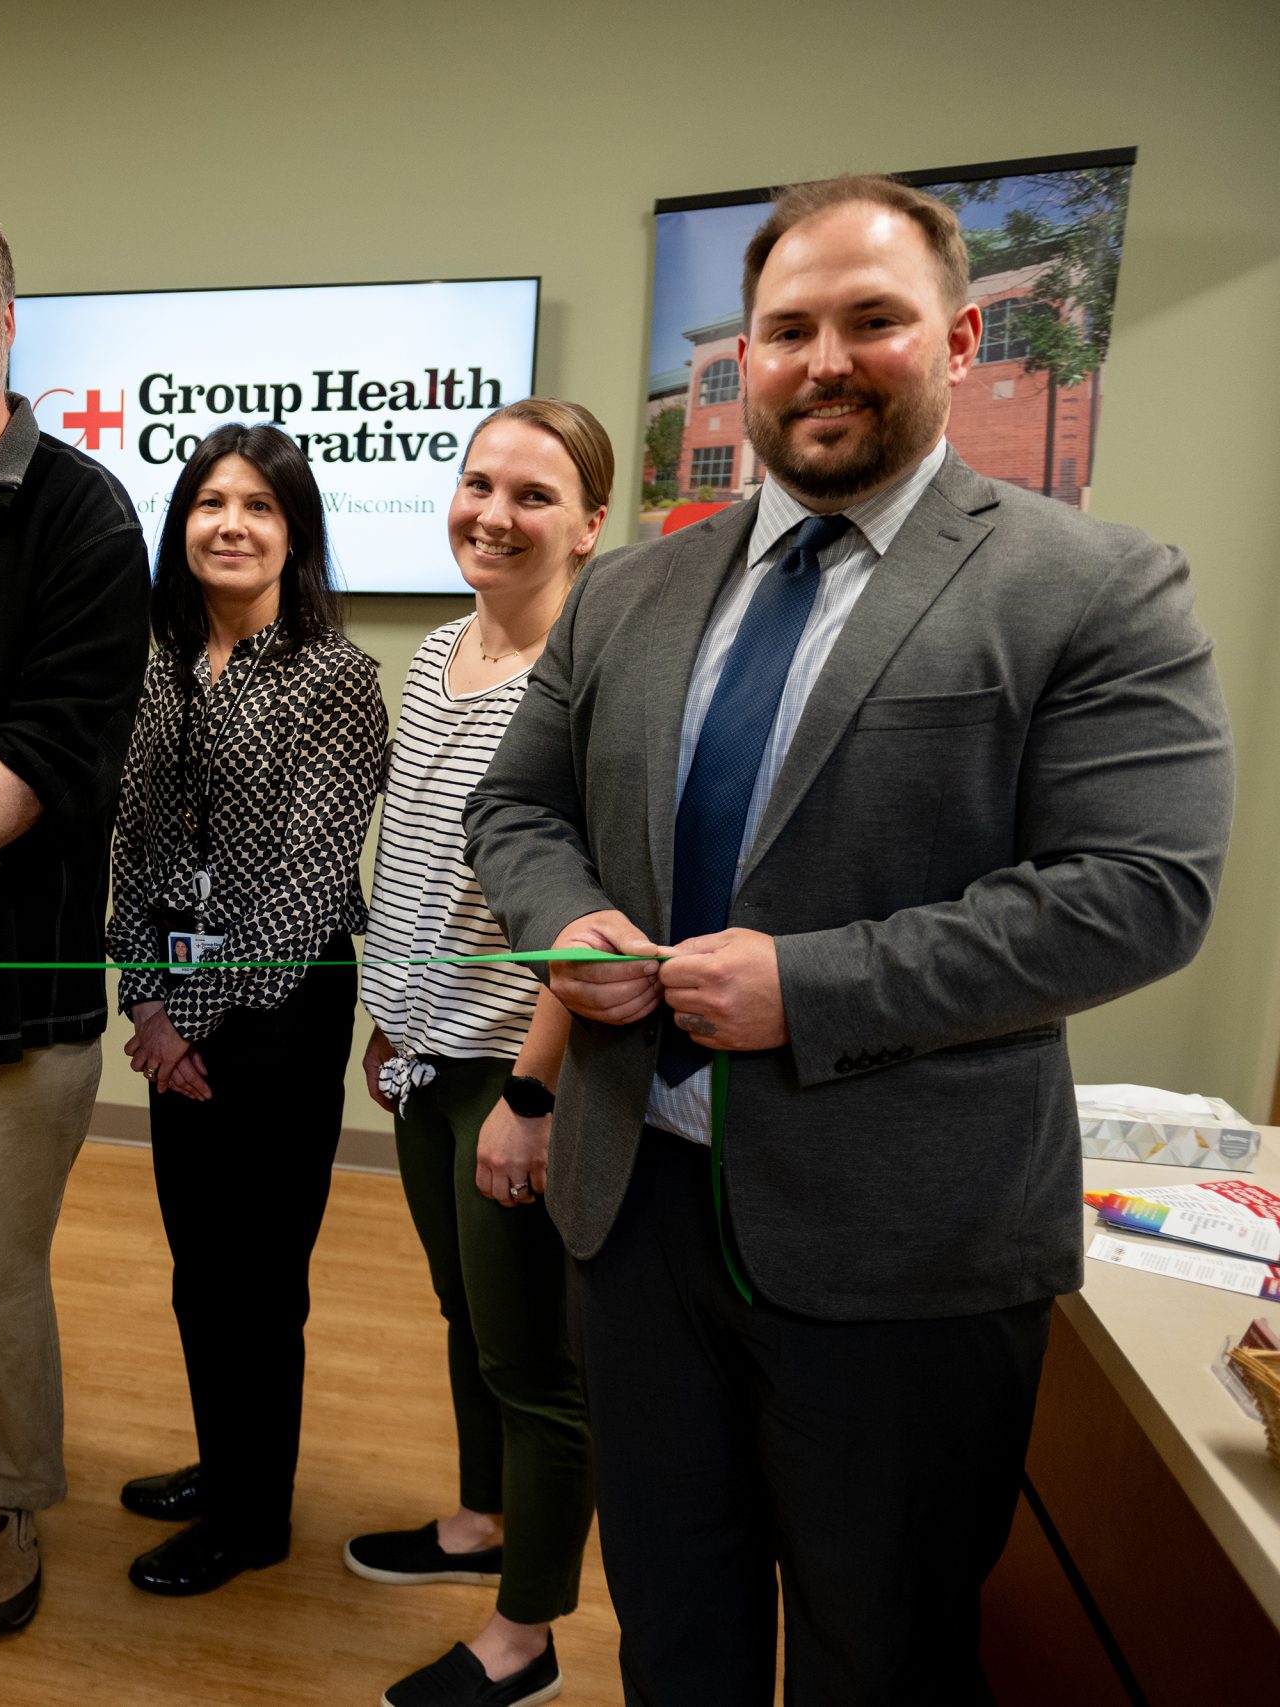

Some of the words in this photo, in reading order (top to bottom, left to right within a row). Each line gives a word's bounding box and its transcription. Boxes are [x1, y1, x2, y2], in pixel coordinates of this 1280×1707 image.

[138, 372, 303, 425] Group
[311, 367, 502, 411] Health
[138, 420, 459, 465] Corative
[137, 492, 157, 513] of
[322, 491, 435, 513] Wisconsin
